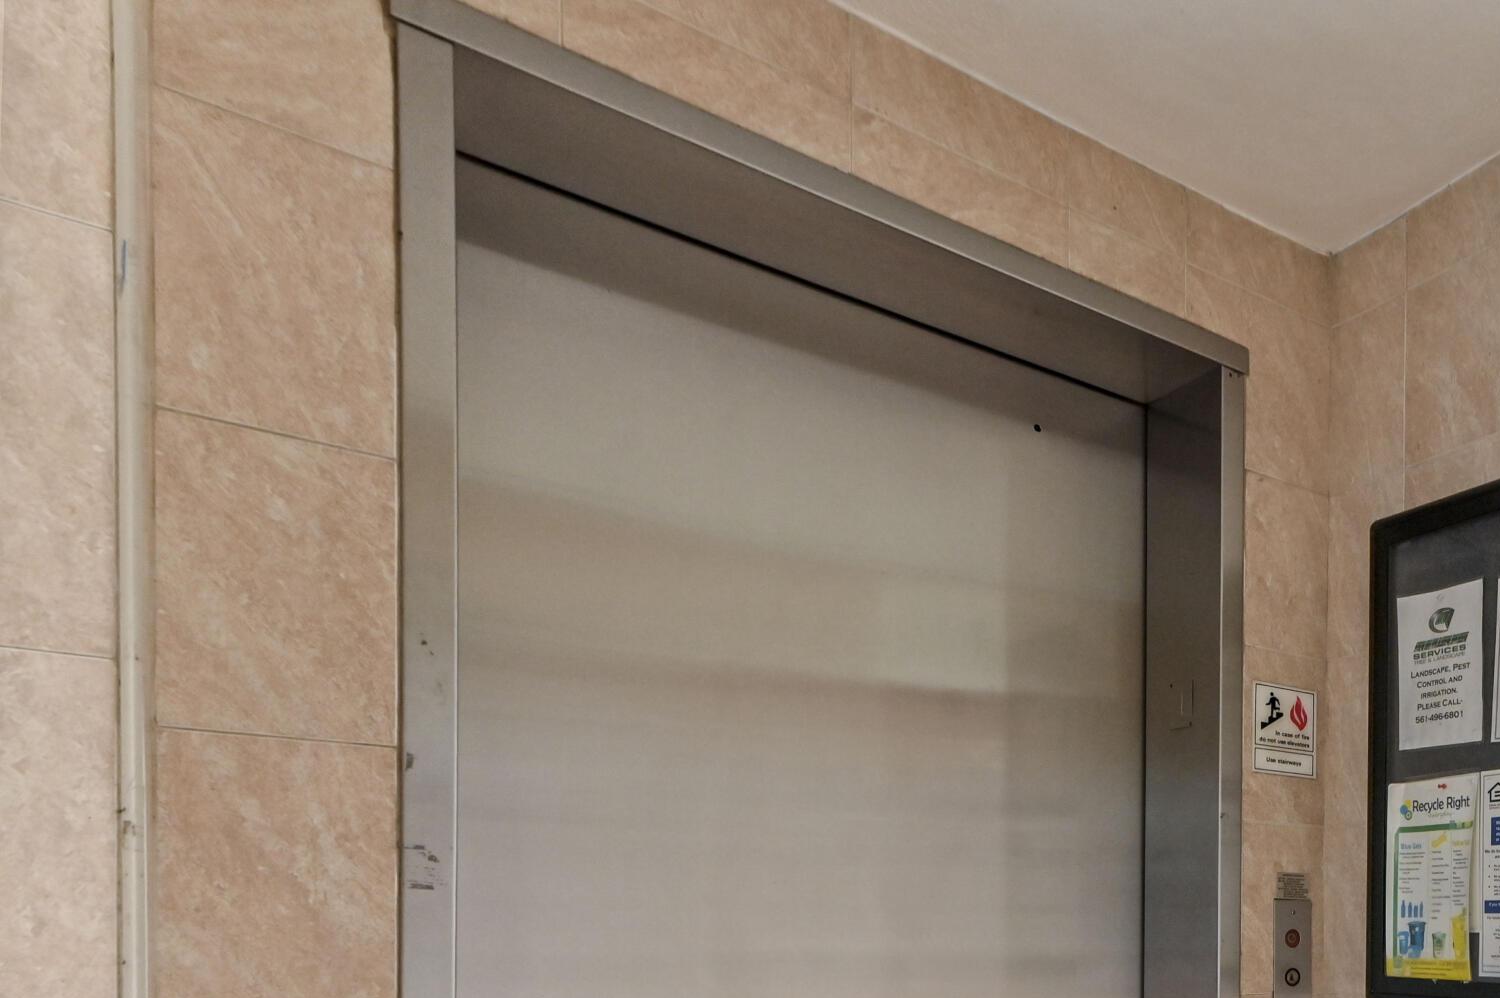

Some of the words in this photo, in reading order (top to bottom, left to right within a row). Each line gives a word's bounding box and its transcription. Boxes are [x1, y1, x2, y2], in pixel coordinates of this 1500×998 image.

[1413, 644, 1466, 660] SERVICES
[1453, 662, 1471, 671] PEST
[1417, 679, 1447, 688] CONTROL
[1448, 675, 1463, 683] AND
[1417, 701, 1440, 711] PLEASE
[1277, 759, 1302, 767] stairways
[1413, 798, 1444, 813] Recycle
[1447, 795, 1470, 810] Right
